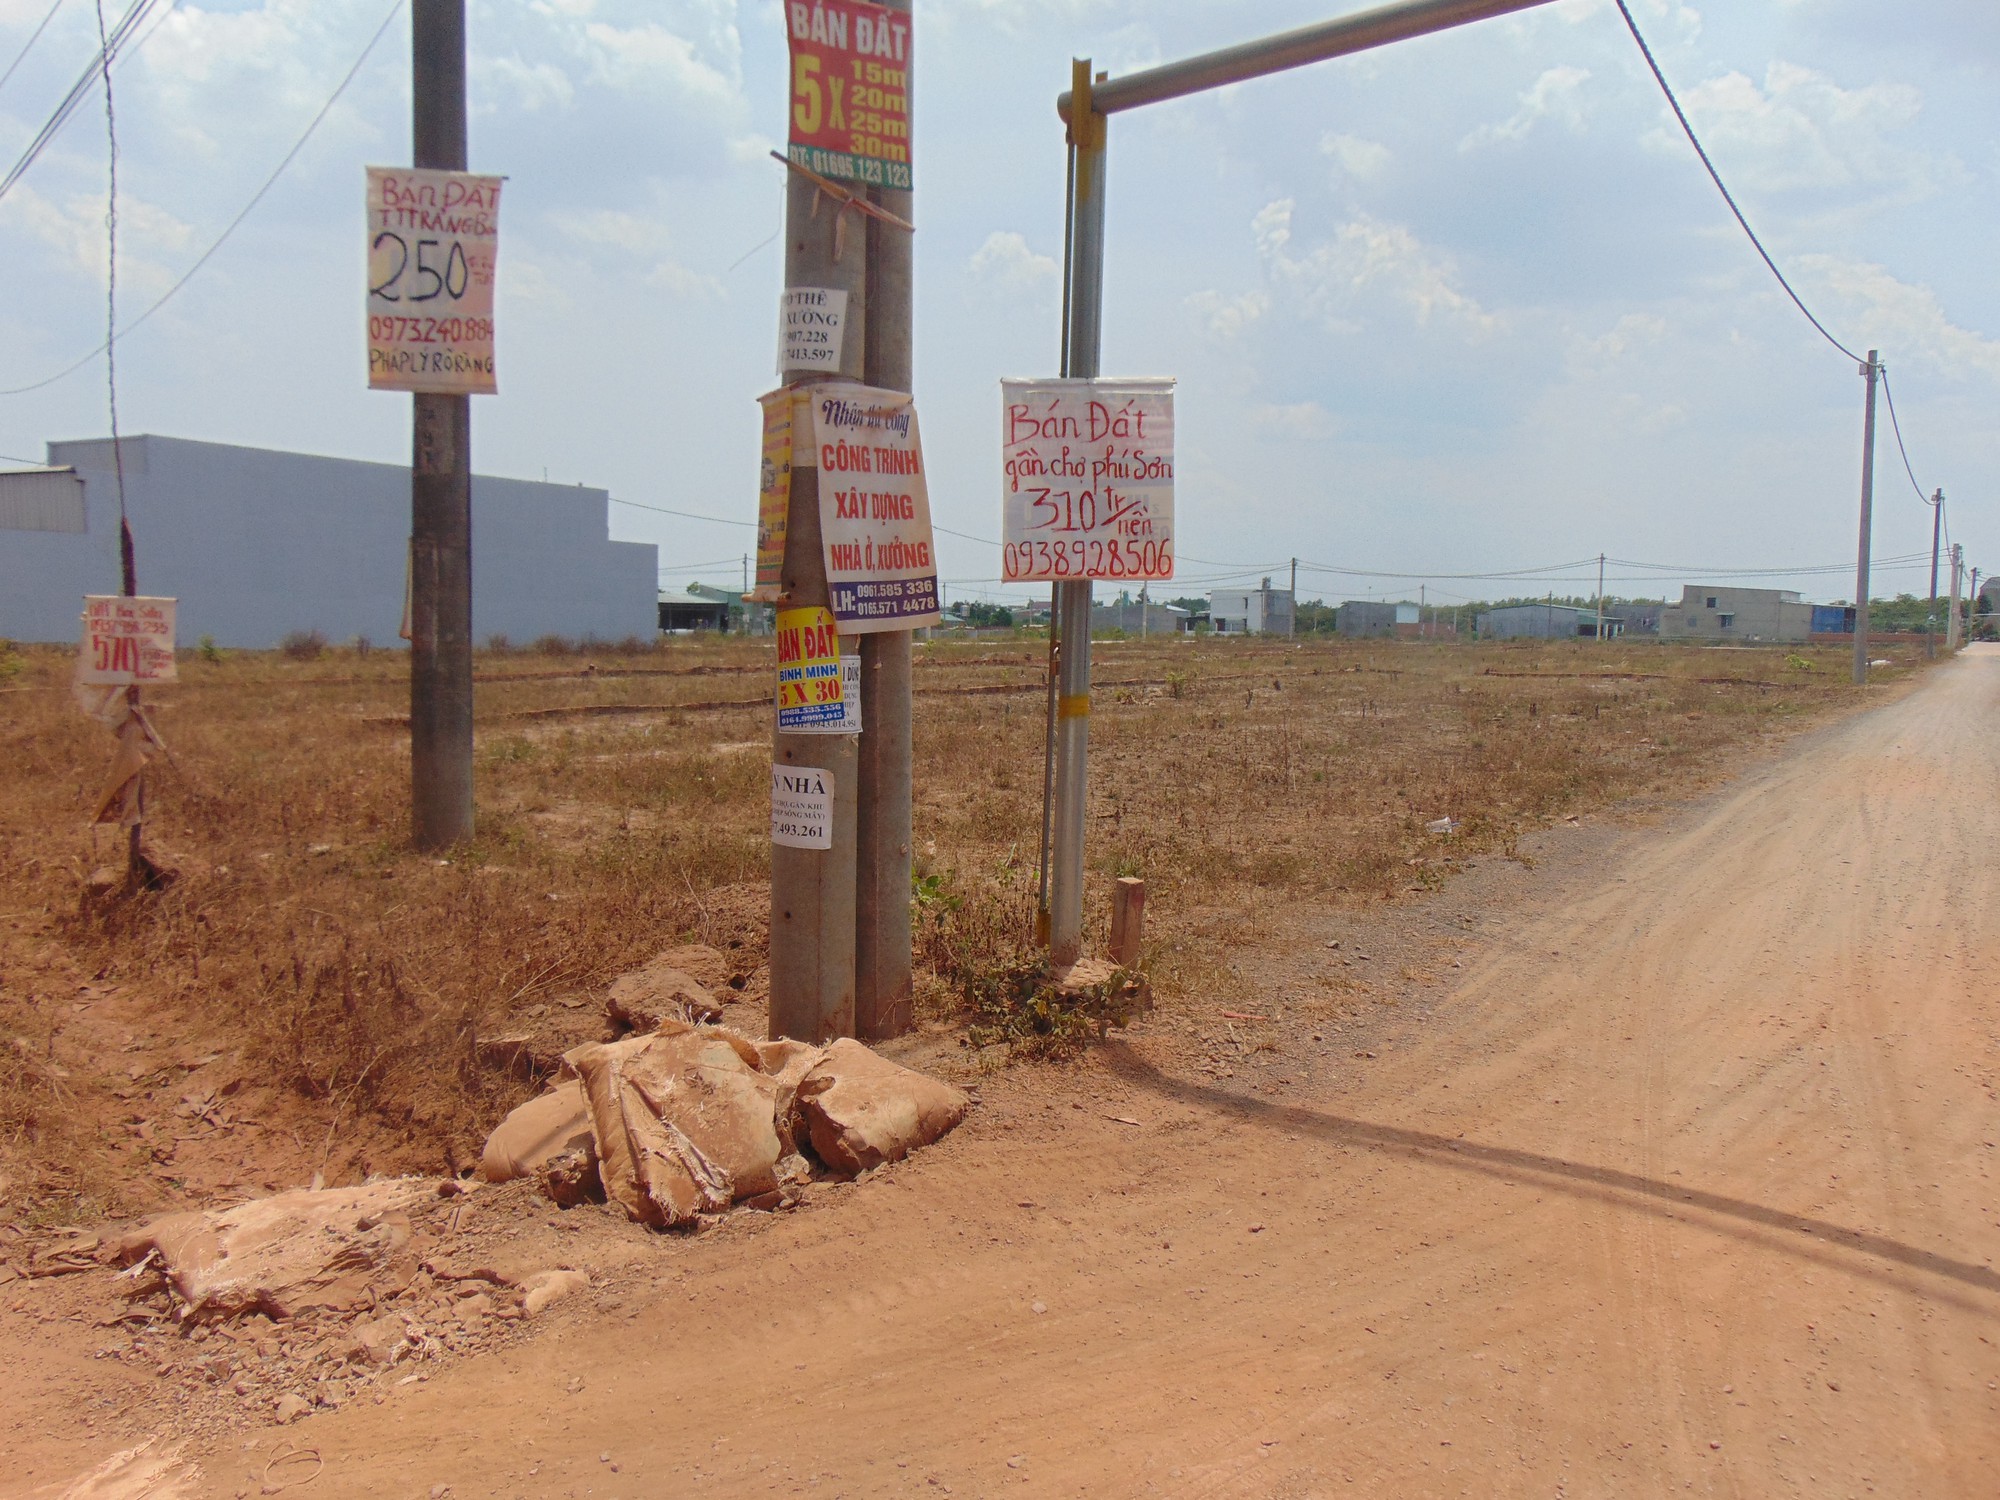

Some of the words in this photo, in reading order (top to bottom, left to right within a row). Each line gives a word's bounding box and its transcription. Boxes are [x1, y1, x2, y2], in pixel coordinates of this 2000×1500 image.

[791, 0, 848, 50] BÁN
[856, 9, 906, 61] ĐẤT
[851, 60, 906, 88] 15m
[794, 54, 822, 134] 5
[852, 85, 907, 114] 20m
[851, 109, 907, 138] 25m
[851, 133, 906, 162] 30m
[858, 159, 882, 183] 123
[886, 164, 910, 188] 123
[370, 231, 468, 302] 250
[1002, 398, 1081, 448] Bán
[1080, 399, 1147, 443] Đất
[821, 438, 872, 473] CÔNG
[873, 443, 920, 475] TRÌNH
[1004, 447, 1048, 493] gần
[1050, 445, 1086, 484] chợ
[1092, 444, 1130, 496] phú
[1133, 449, 1173, 480] Sơn
[834, 486, 868, 520] XÂY
[1022, 487, 1096, 533] 310
[830, 538, 862, 571] NHÀ
[832, 590, 856, 612] LH:
[906, 580, 933, 595] 336
[902, 597, 935, 612] 4478
[804, 610, 835, 660] ĐẤT
[805, 663, 838, 679] MINH
[780, 684, 789, 707] 5
[793, 682, 809, 705] X
[815, 678, 840, 702] 30
[783, 774, 826, 795] NHÀ
